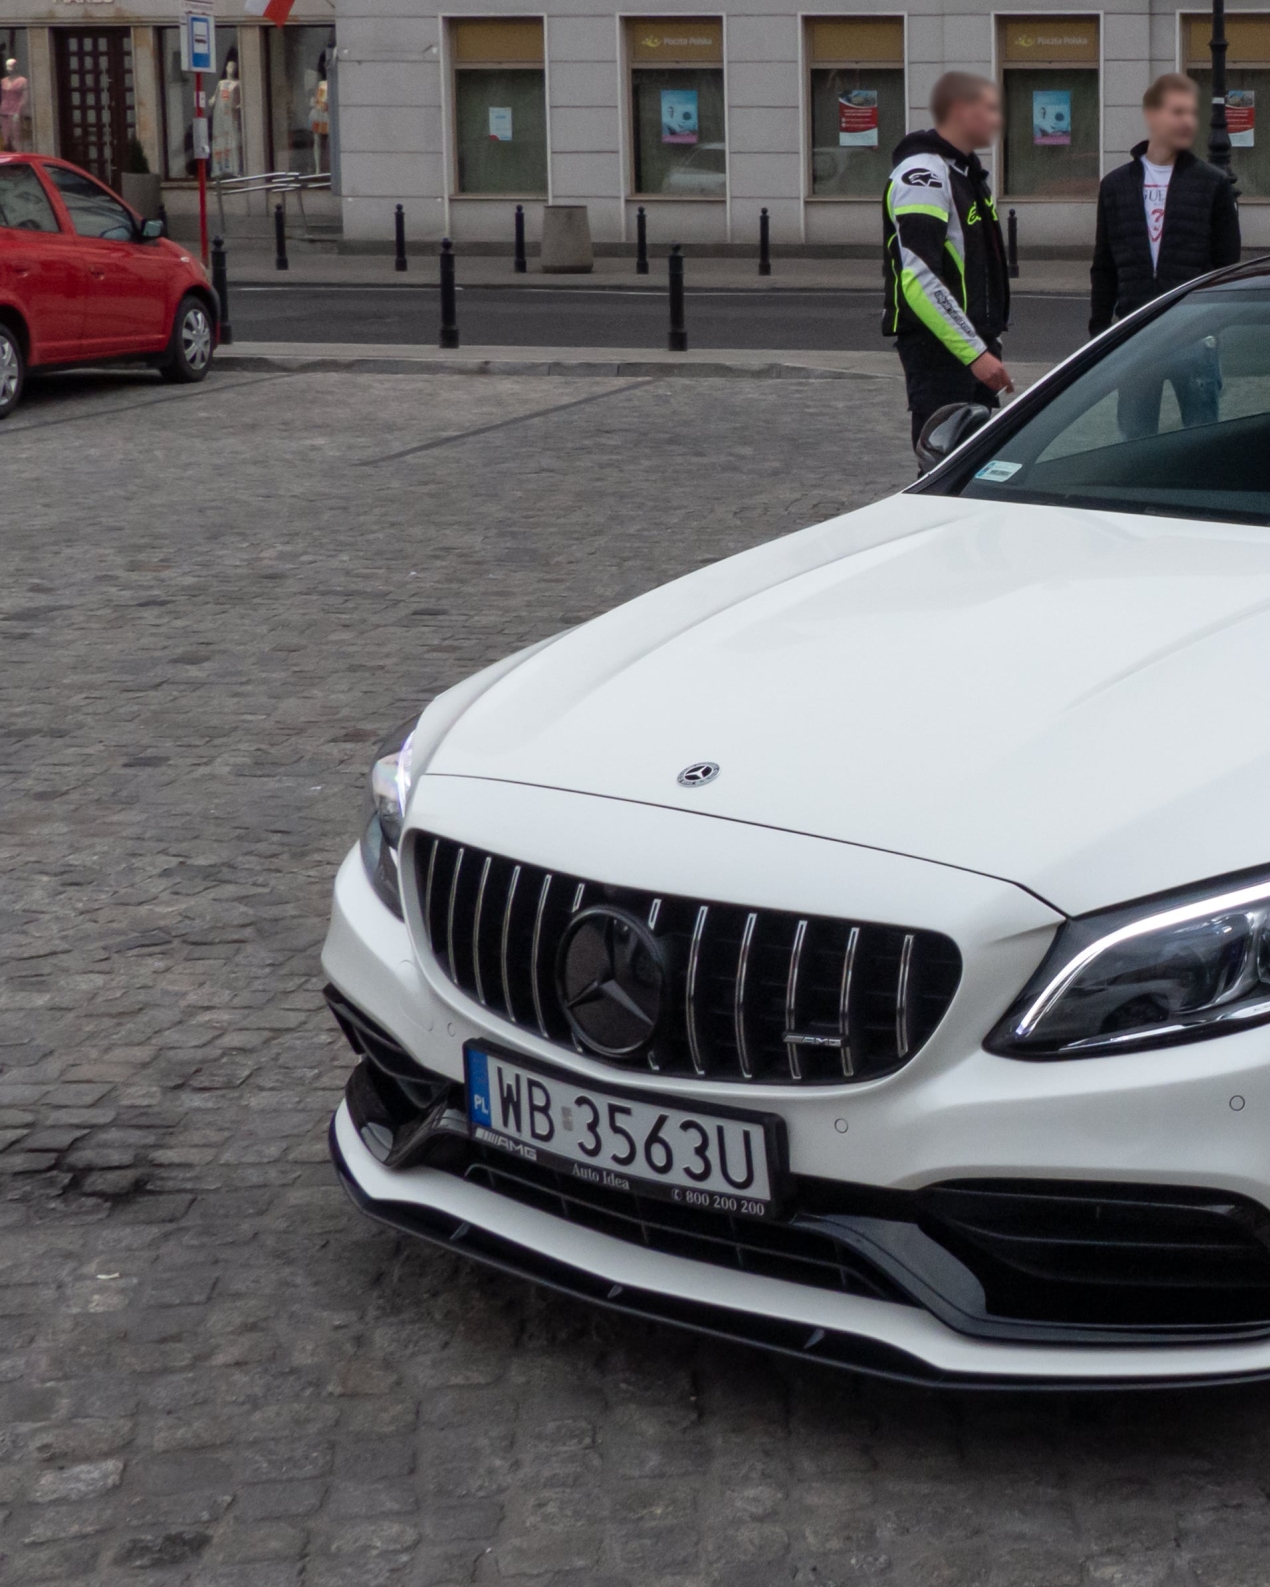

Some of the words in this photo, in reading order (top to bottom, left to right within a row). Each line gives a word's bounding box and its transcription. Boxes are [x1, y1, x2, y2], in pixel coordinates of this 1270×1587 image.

[474, 1094, 489, 1115] PL
[497, 1066, 556, 1143] WB
[574, 1095, 755, 1191] 3563U
[572, 1163, 600, 1182] Auto
[602, 1170, 630, 1191] Idea
[686, 1190, 709, 1206] 800
[713, 1195, 737, 1211] 200
[741, 1200, 765, 1217] 200
